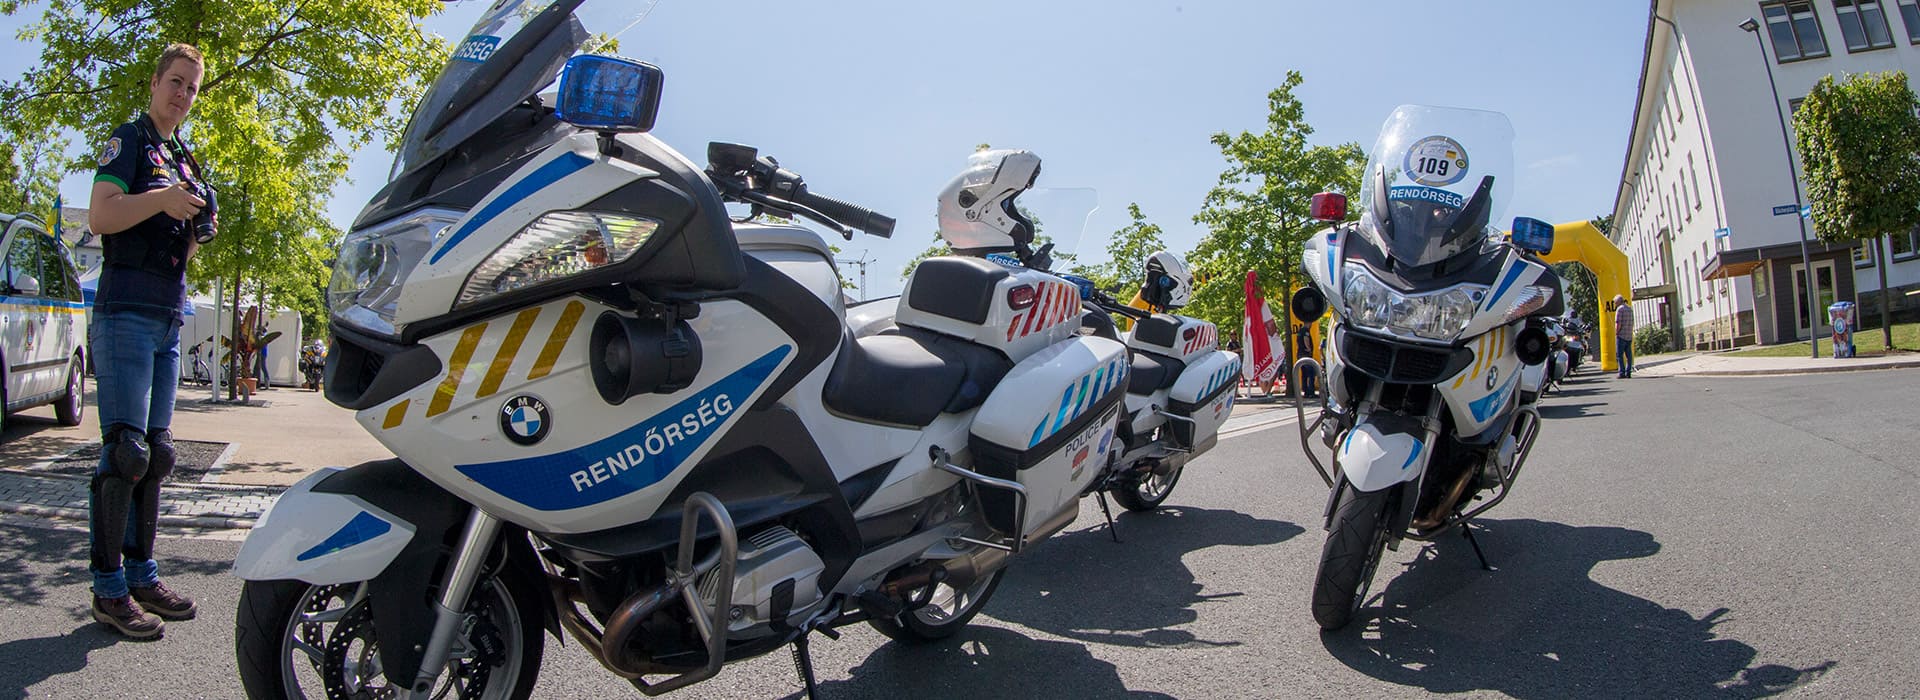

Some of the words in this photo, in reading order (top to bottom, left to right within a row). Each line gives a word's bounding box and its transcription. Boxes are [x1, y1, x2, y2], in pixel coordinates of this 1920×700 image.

[1418, 157, 1449, 176] 109
[1390, 187, 1462, 207] RENDŐRSÉG
[503, 397, 545, 416] BMW
[570, 393, 734, 493] RENDŐRSÉG
[1065, 420, 1100, 457] POLICE
